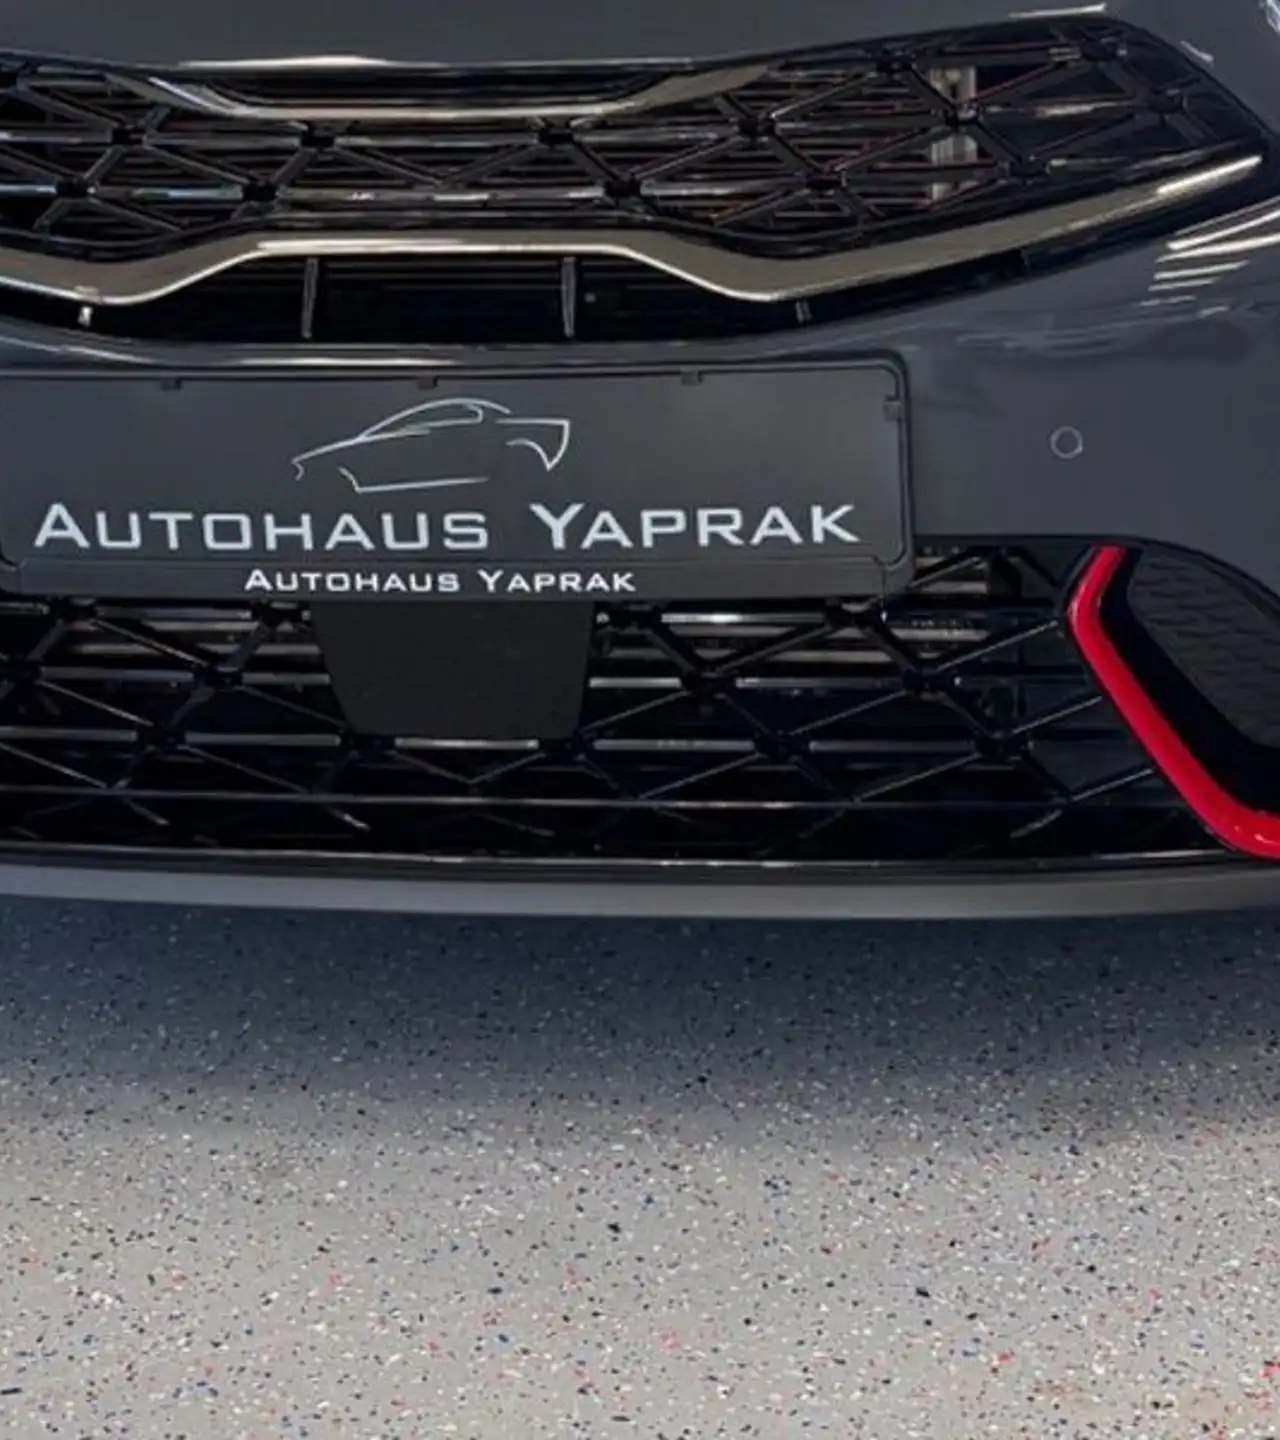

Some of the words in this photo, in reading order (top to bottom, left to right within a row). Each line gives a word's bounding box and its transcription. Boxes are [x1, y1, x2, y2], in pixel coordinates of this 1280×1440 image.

[33, 502, 489, 551] AUTOHAUS
[528, 502, 861, 551] YAPRAK
[244, 568, 460, 593] AUTOHAUS
[477, 569, 637, 593] YAPRAK
